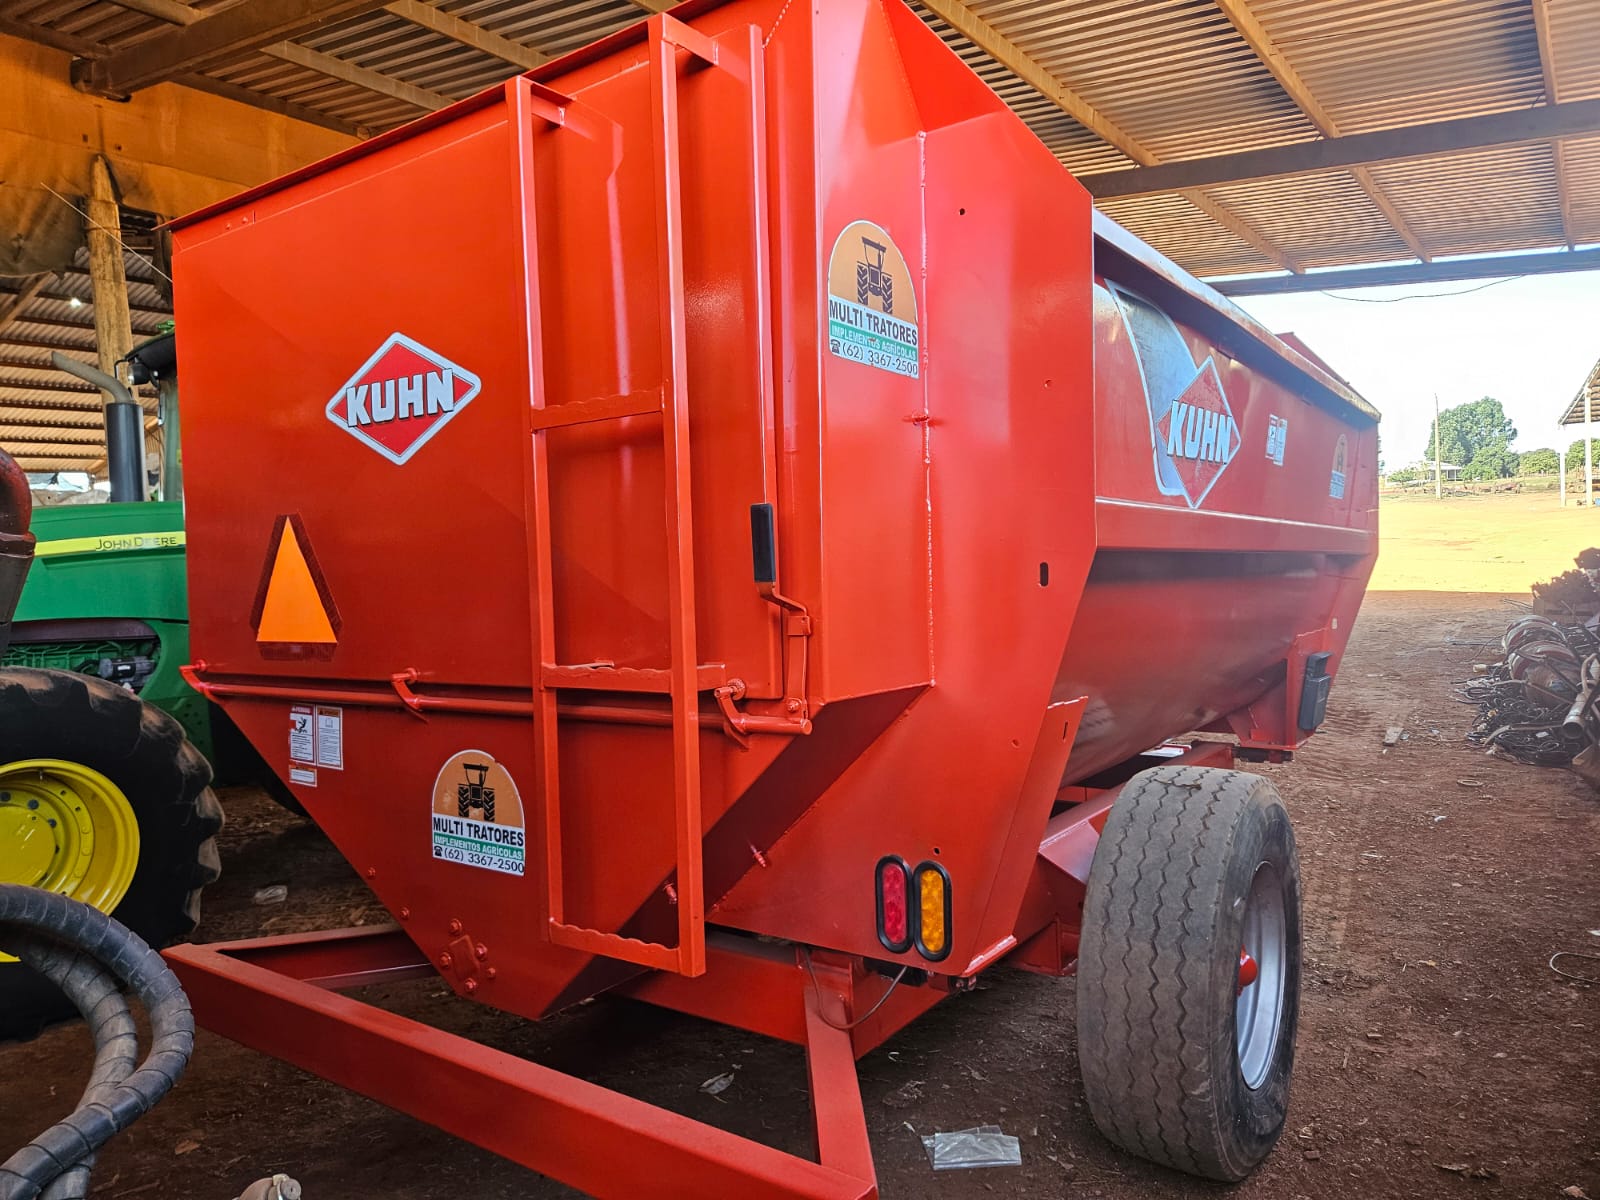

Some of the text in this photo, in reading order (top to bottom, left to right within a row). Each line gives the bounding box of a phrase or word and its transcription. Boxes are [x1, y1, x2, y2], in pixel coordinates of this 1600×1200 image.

[829, 299, 917, 346] MULTI TRATORES
[842, 342, 918, 375] (62) 3367-2500
[346, 368, 454, 428] KUHN
[1167, 399, 1232, 465] KUHN
[95, 538, 132, 551] JOHN
[433, 817, 524, 846] MULTI TRATORES
[434, 835, 522, 860] IMPLEMENTOS AGRÍCOLAS
[444, 847, 525, 873] (62) 3367-2500
